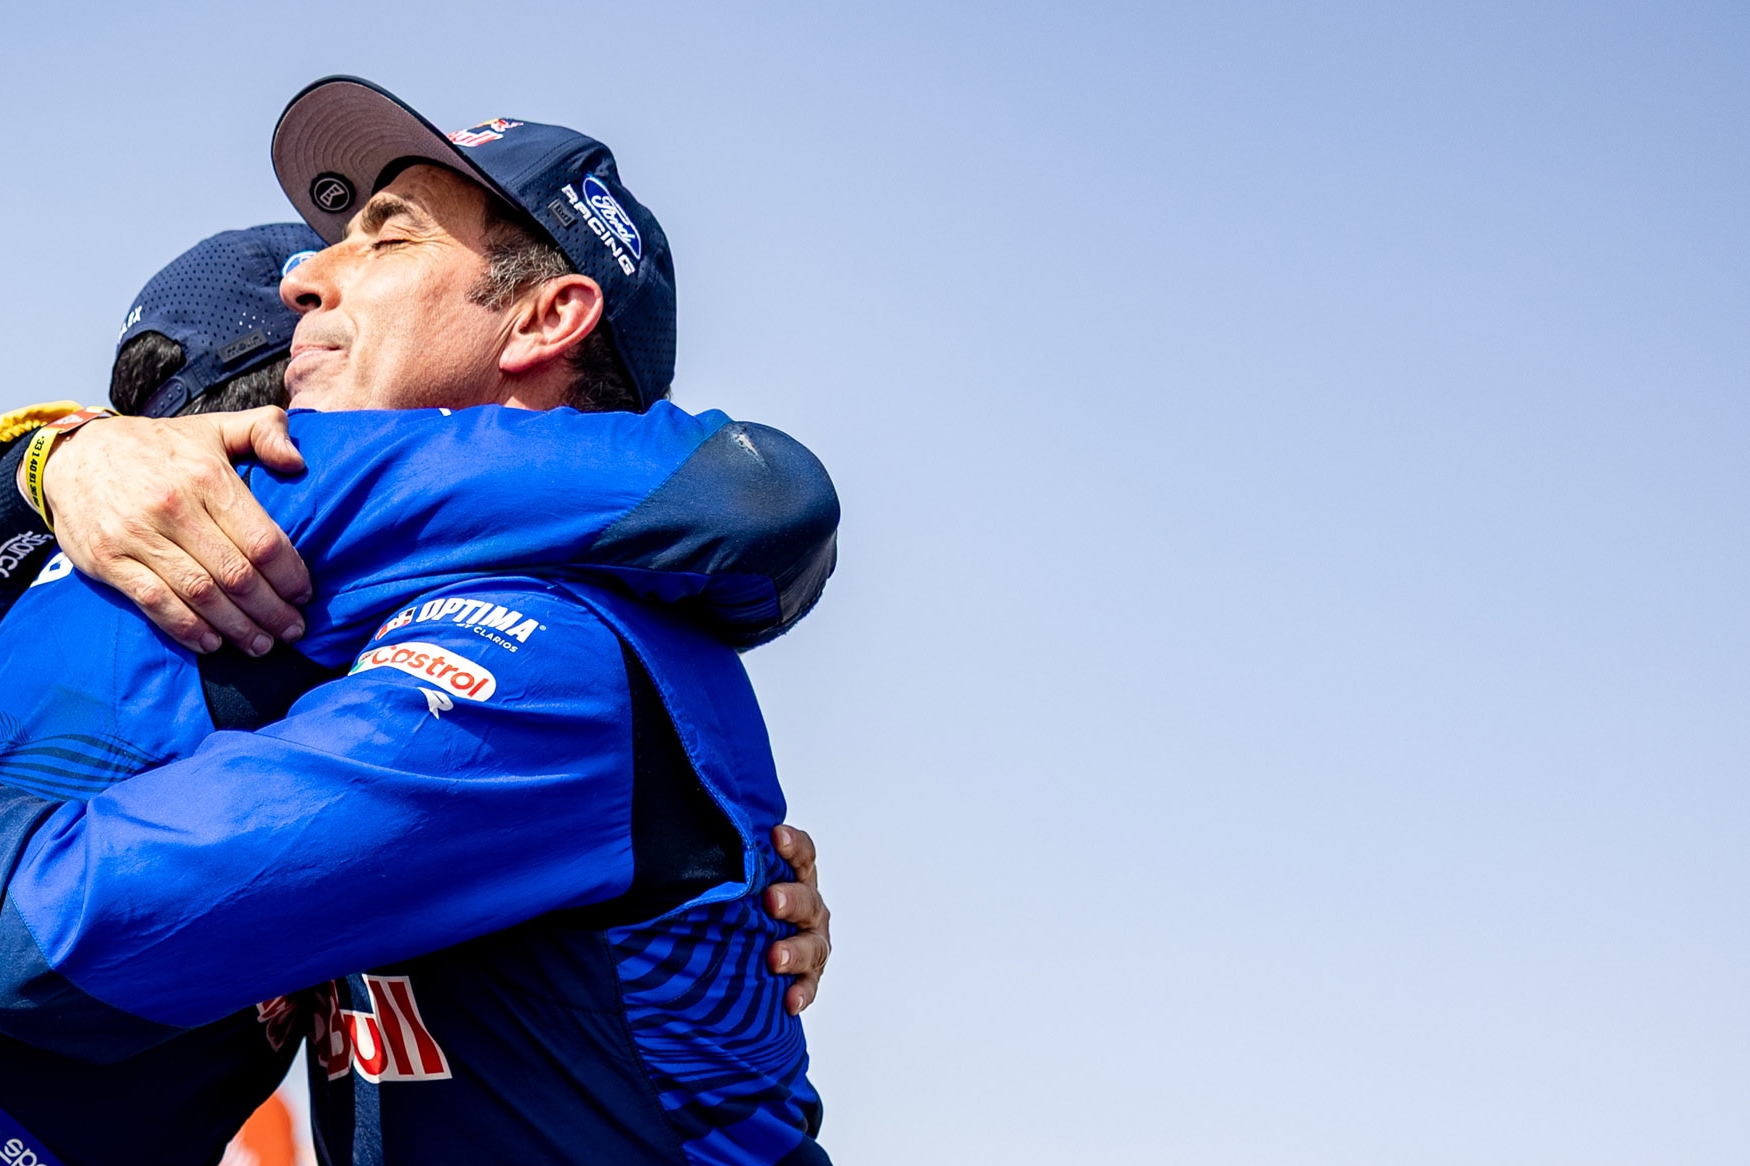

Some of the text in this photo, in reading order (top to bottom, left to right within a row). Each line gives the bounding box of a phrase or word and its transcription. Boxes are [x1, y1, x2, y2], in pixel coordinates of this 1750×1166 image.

[560, 183, 636, 276] RACING
[591, 194, 636, 243] Ford
[416, 598, 539, 643] OPTIMA
[473, 625, 519, 653] CLARIOS
[371, 645, 489, 697] Castrol
